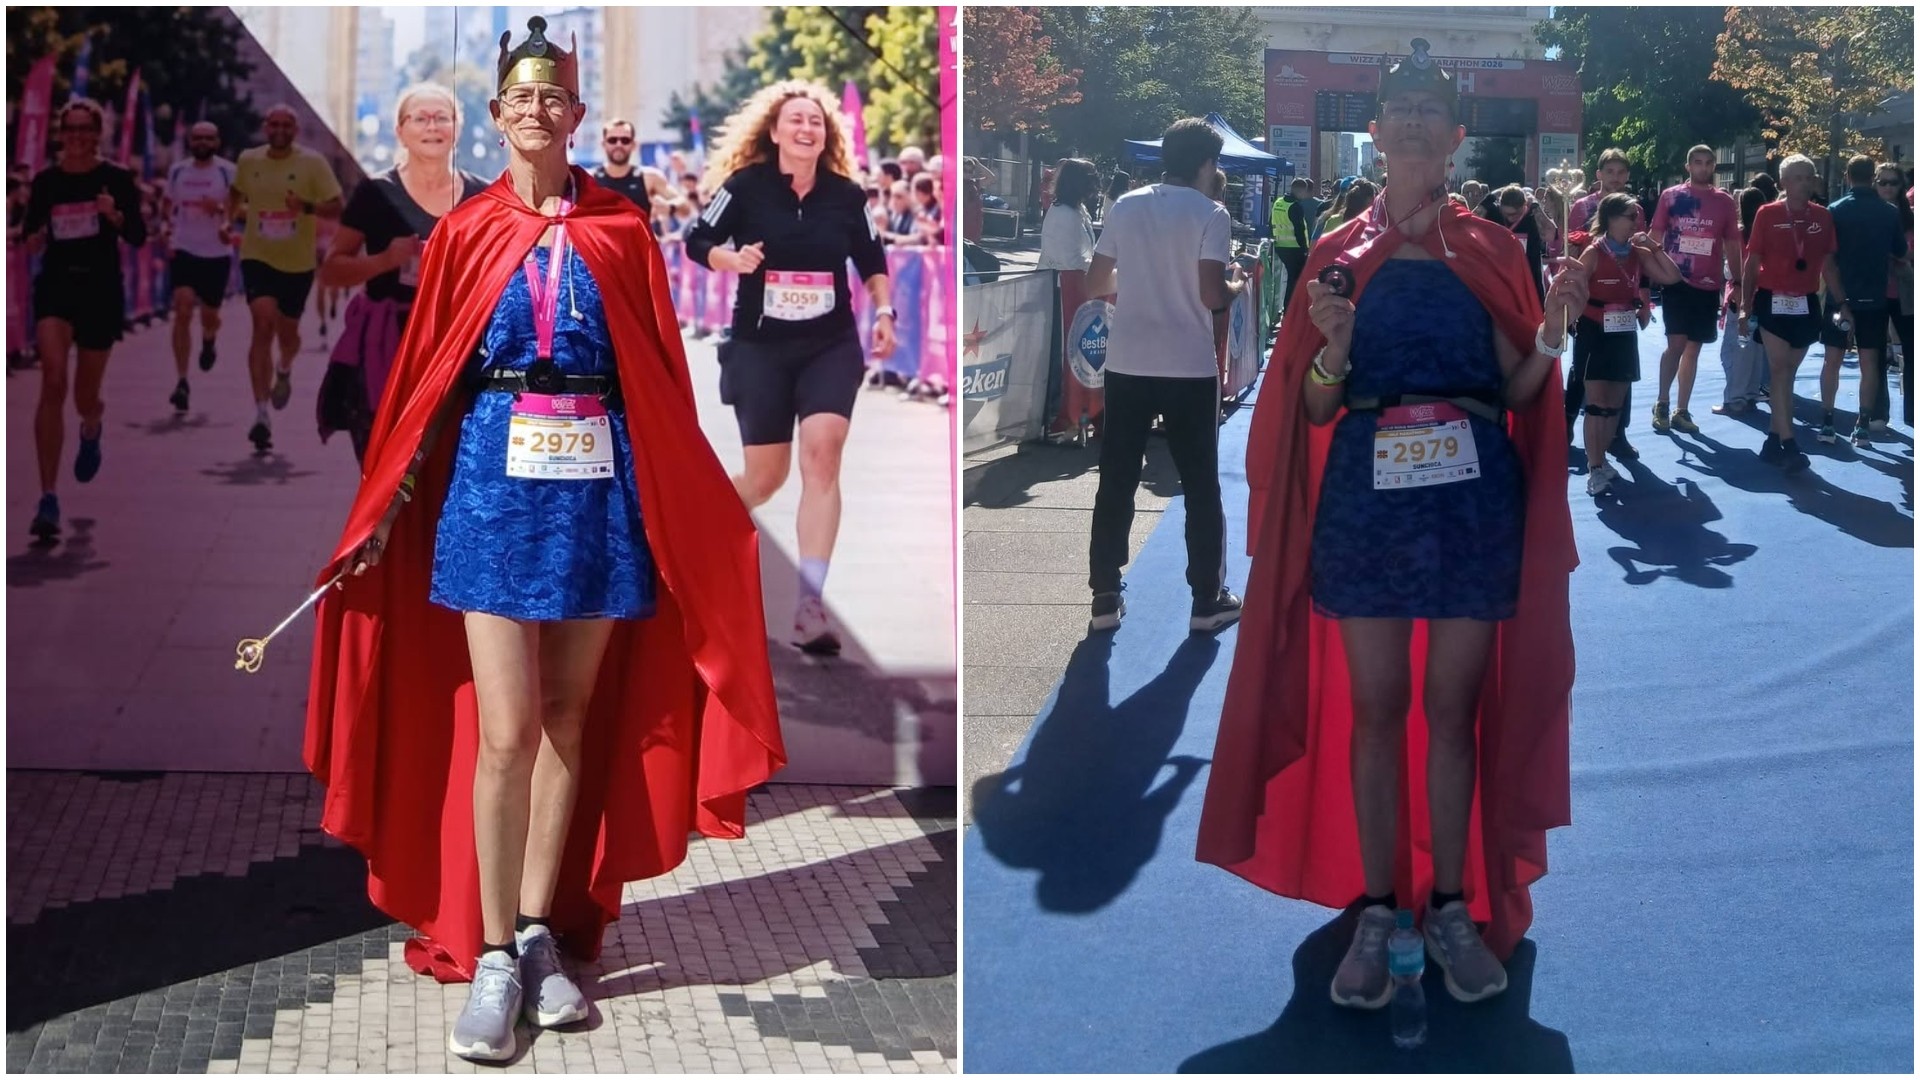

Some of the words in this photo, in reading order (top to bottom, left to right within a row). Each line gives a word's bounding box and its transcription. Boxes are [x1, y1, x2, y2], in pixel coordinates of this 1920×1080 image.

[1350, 56, 1374, 64] WIZZ
[1436, 59, 1480, 68] ARATHON
[1481, 60, 1503, 68] 2026
[1081, 336, 1106, 350] BestB
[530, 432, 595, 453] 2979
[1393, 436, 1458, 463] 2979
